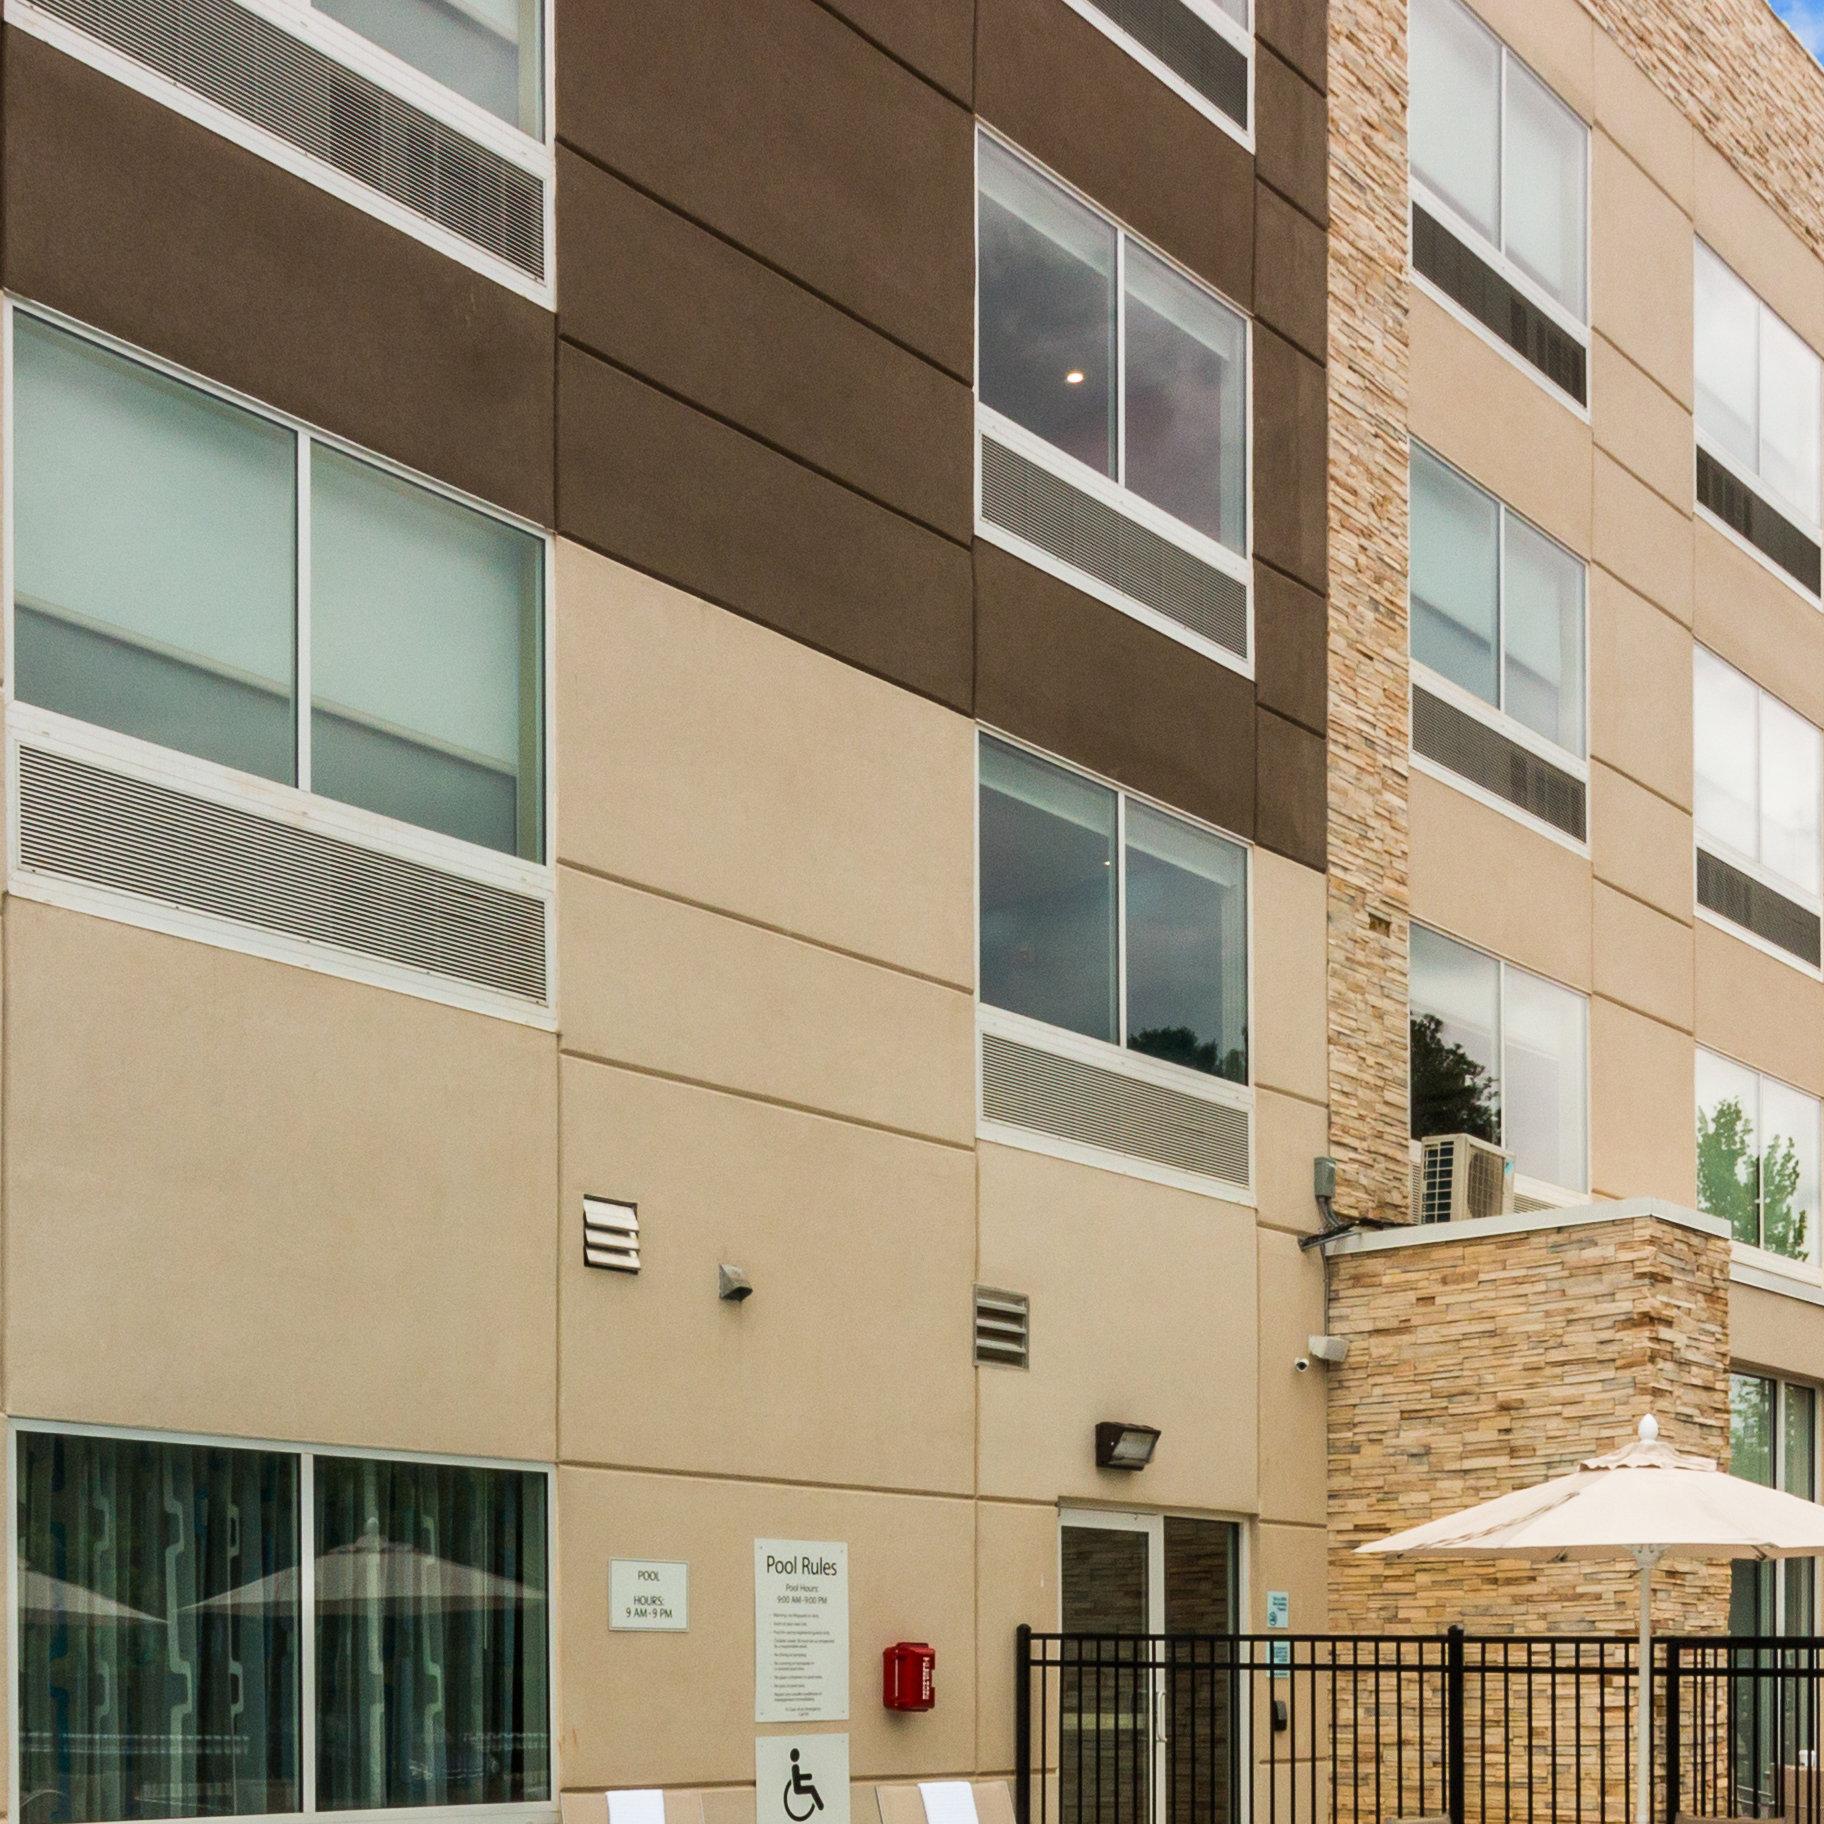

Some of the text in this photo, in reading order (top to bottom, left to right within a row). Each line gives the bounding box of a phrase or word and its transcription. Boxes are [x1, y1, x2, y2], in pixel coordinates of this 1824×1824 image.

[766, 1554, 838, 1577] Pool Rules
[637, 1570, 661, 1582] POOL
[633, 1595, 665, 1606] HOURS:
[625, 1607, 632, 1618] 9
[659, 1608, 673, 1618] PM
